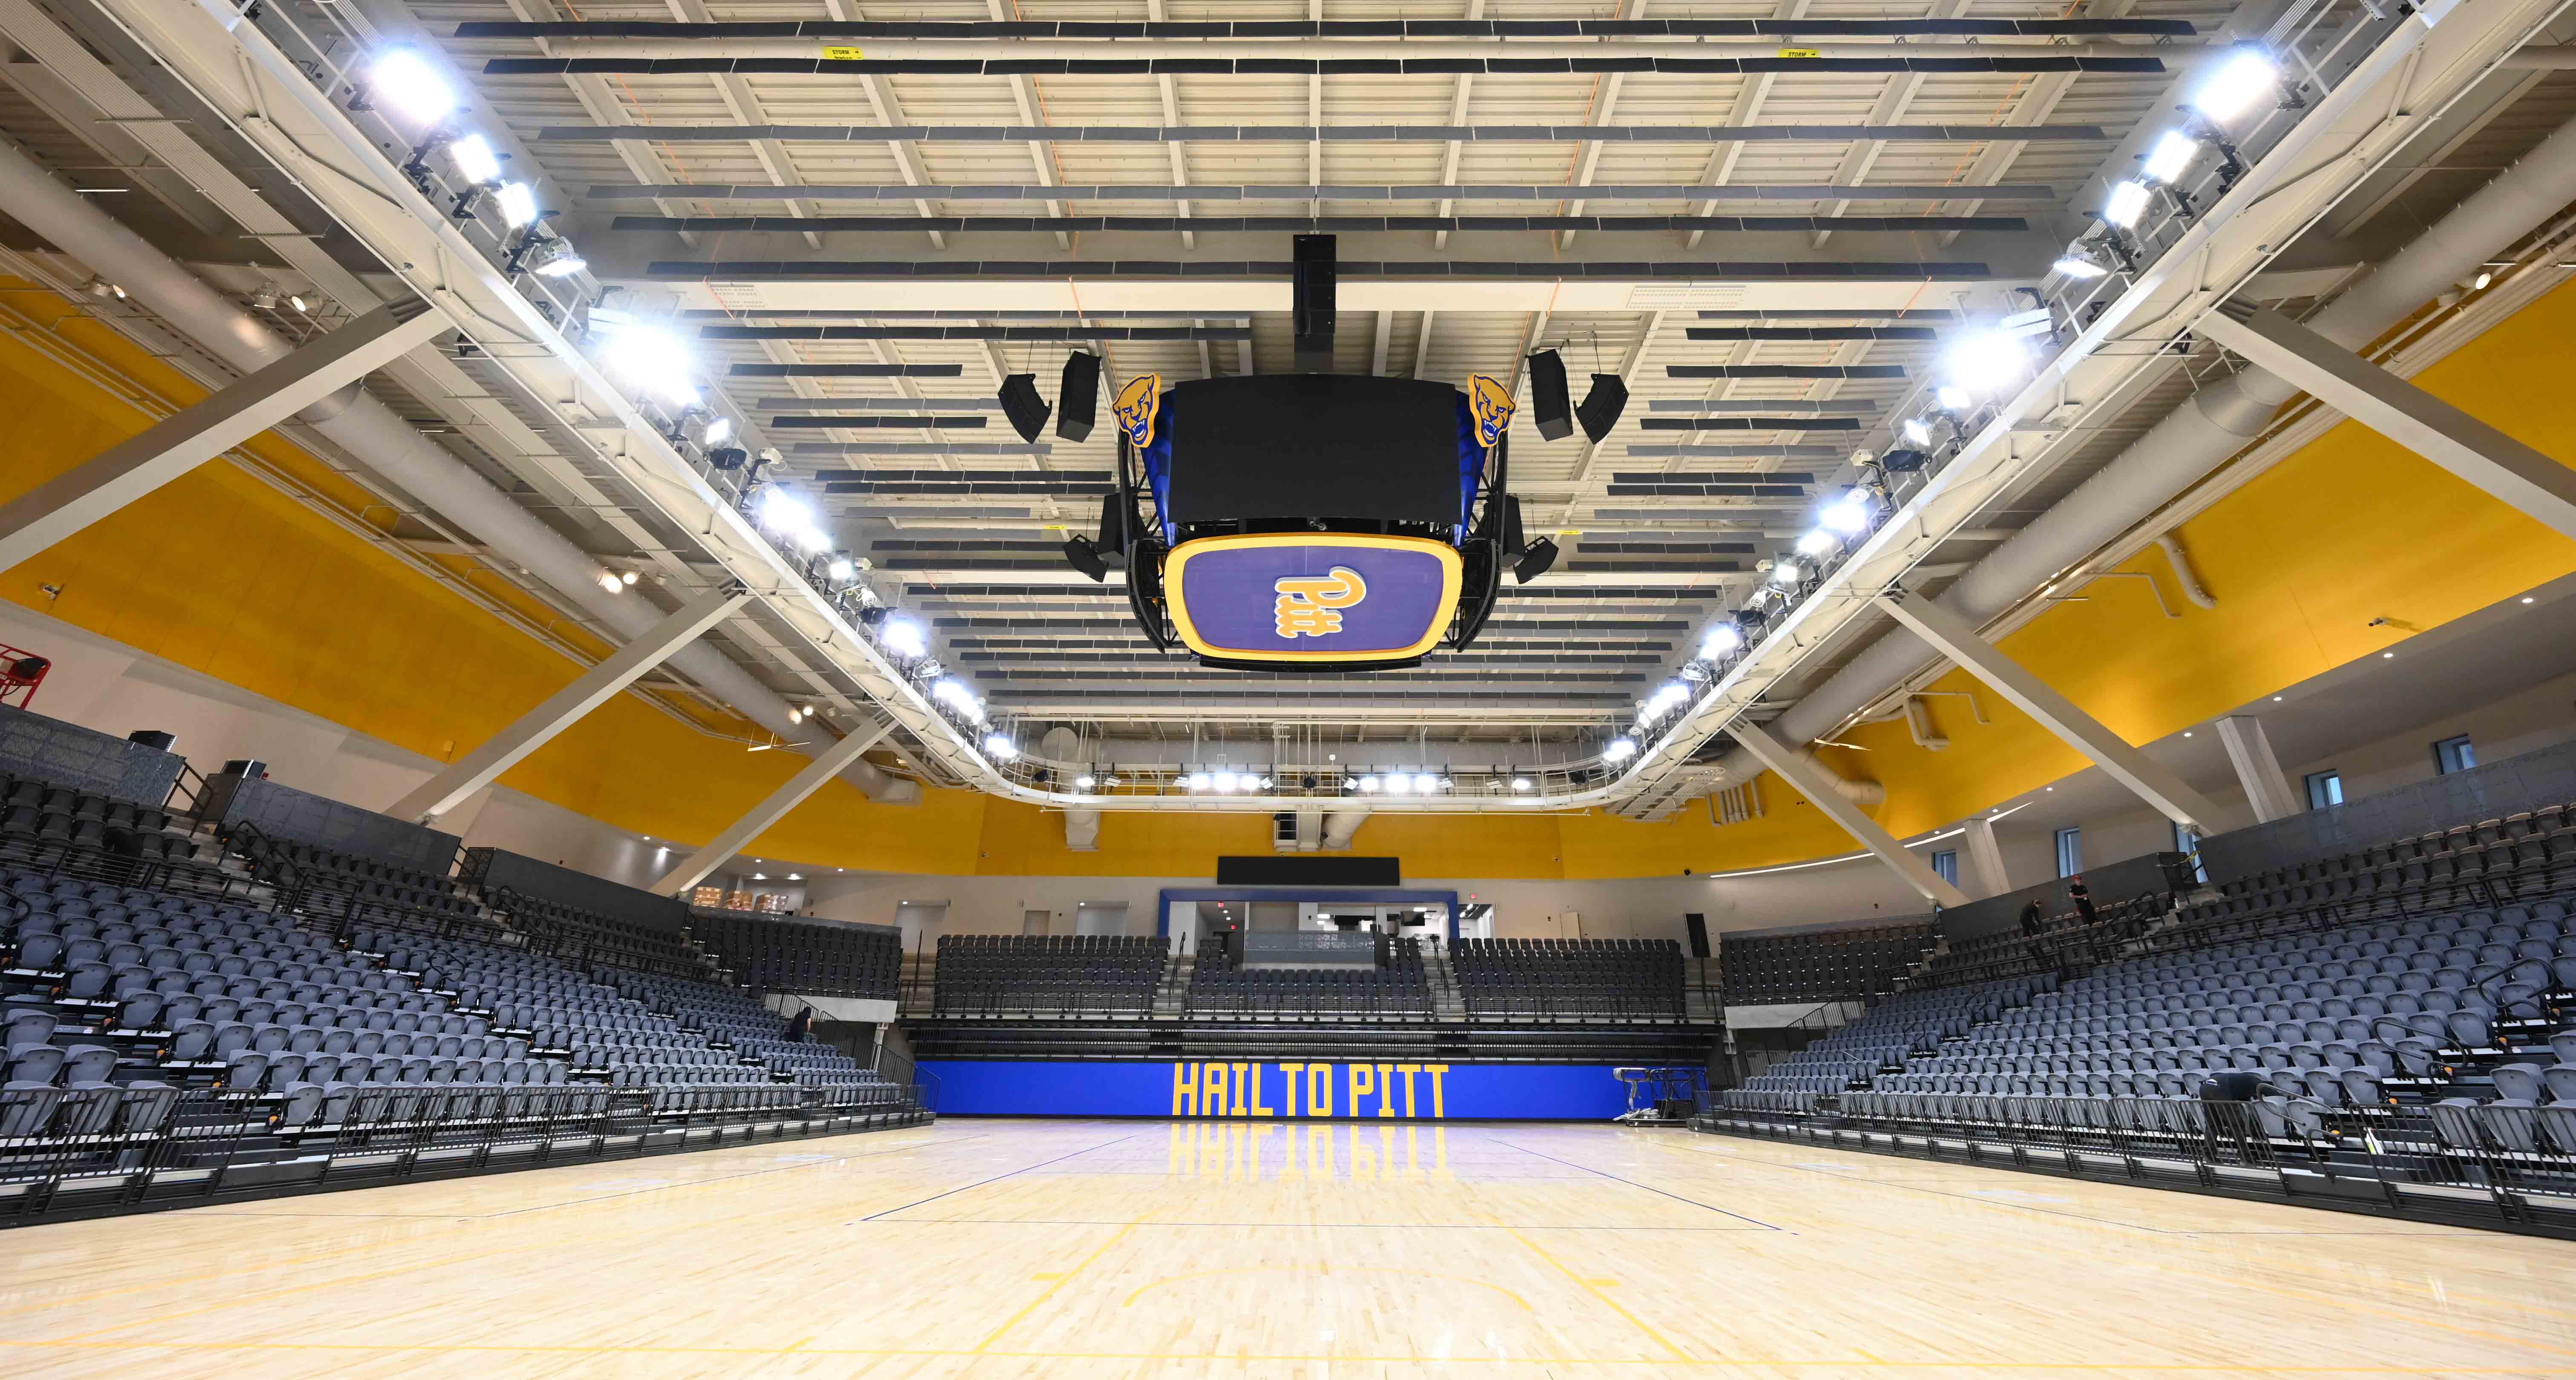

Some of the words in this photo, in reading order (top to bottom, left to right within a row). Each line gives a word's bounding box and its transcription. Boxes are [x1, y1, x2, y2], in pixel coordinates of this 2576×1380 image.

[1172, 1063, 1273, 1116] HAIL
[1279, 1063, 1332, 1116] TO
[1349, 1064, 1449, 1118] PITT
